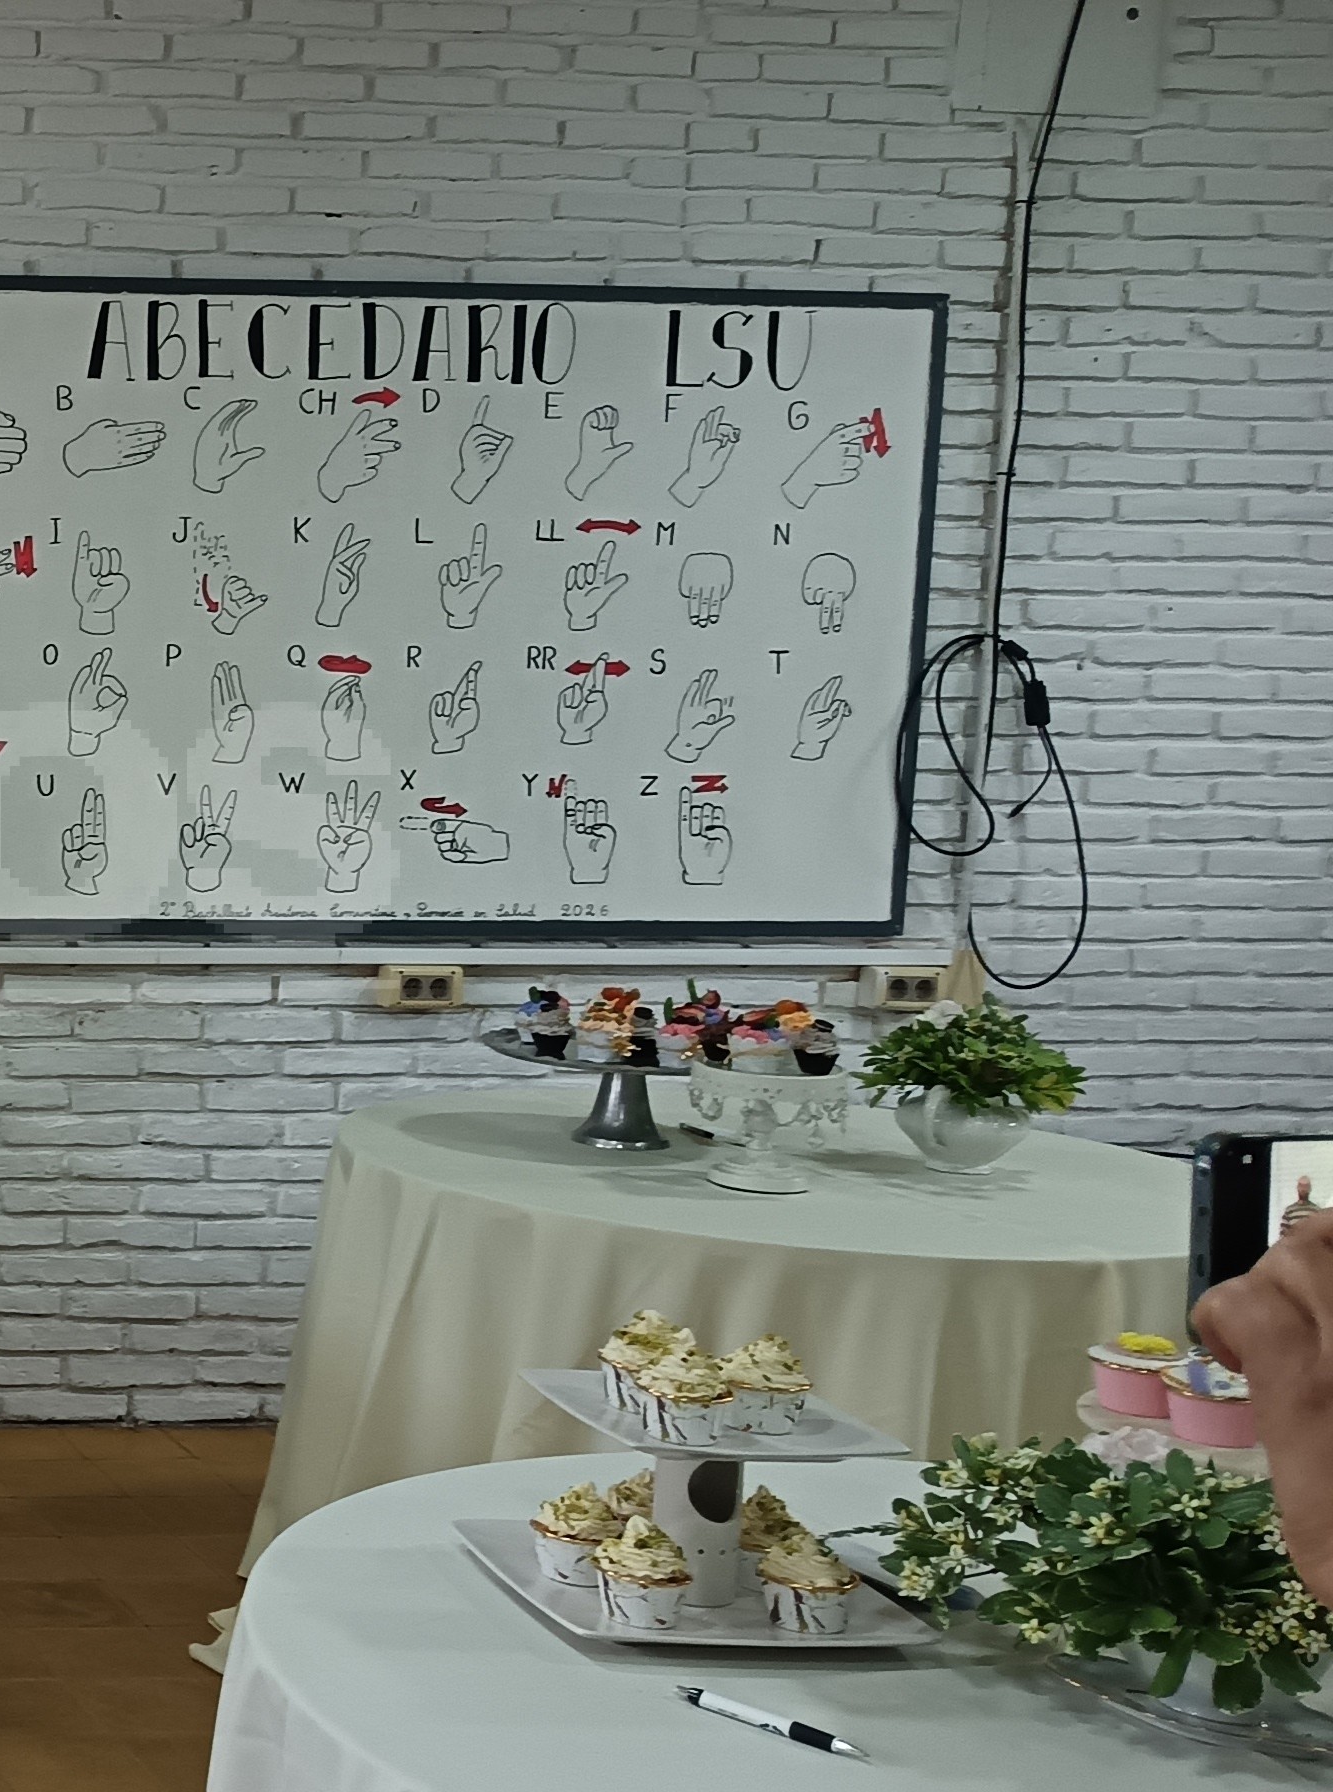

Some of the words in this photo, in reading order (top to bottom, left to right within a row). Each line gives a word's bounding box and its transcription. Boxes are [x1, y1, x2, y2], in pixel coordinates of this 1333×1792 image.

[85, 298, 578, 386] ABECEDARIO
[663, 308, 819, 392] LSU
[55, 384, 74, 412] B
[183, 385, 202, 411] C
[298, 387, 338, 416] CH
[422, 387, 441, 414] D
[544, 391, 565, 420] E
[664, 393, 684, 423] F
[787, 400, 810, 431] G
[48, 517, 62, 545] I
[172, 516, 193, 544] J
[293, 516, 312, 544] K
[414, 517, 435, 545] L
[535, 518, 566, 542] LL
[655, 521, 676, 547] M
[773, 522, 791, 546] N
[42, 643, 59, 666] O
[165, 643, 182, 668] P
[286, 644, 307, 669] Q
[406, 645, 422, 669] R
[526, 645, 558, 671] RR
[649, 647, 667, 675] S
[768, 649, 791, 675] T
[36, 773, 55, 797] U
[156, 772, 178, 796] V
[278, 771, 306, 794] W
[399, 768, 418, 791] X
[521, 773, 540, 797] Y
[639, 775, 659, 797] Z
[560, 903, 610, 917] 2026
